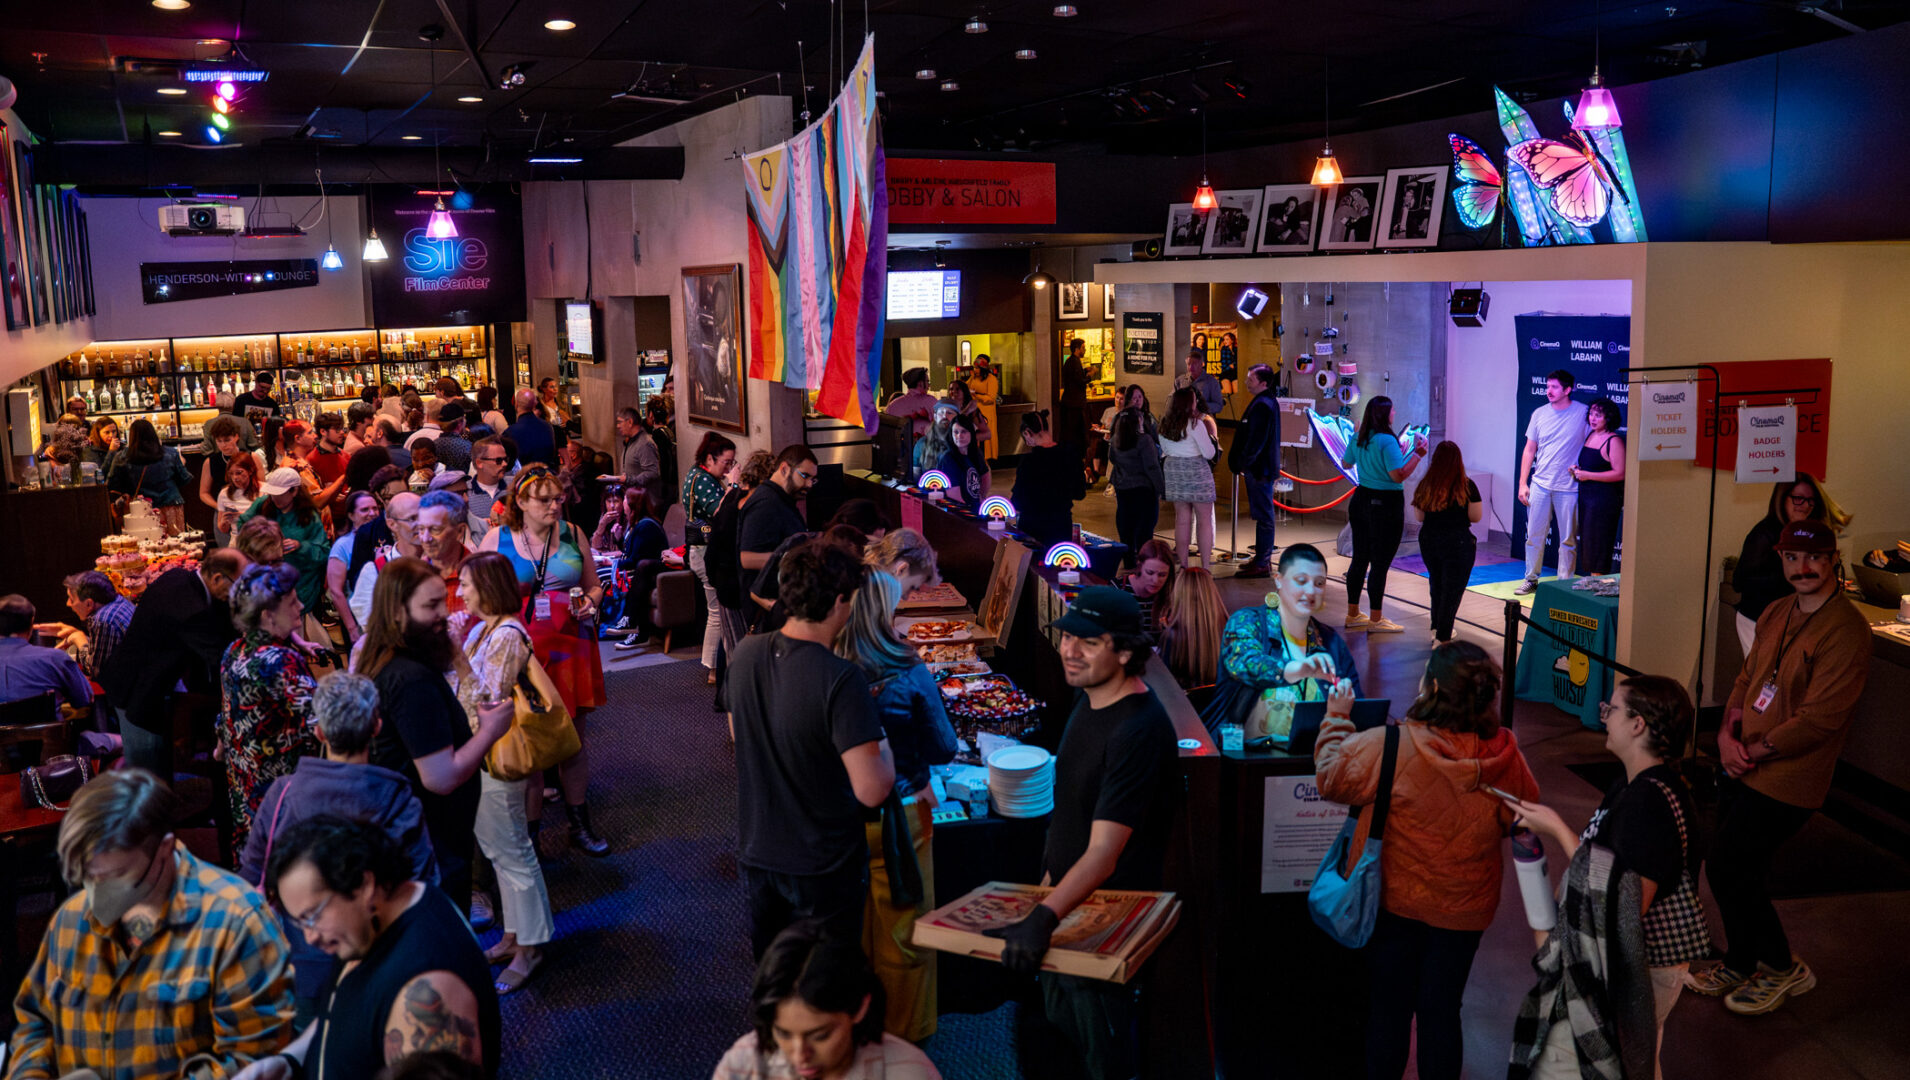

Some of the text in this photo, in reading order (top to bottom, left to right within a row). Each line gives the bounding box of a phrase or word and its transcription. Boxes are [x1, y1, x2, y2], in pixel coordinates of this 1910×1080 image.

[887, 187, 1021, 207] OBBY & SALON
[403, 226, 488, 273] Sie
[267, 270, 311, 282] OUNGE
[404, 276, 491, 292] FilmCenter
[1207, 337, 1221, 350] MY
[1571, 340, 1602, 350] WILLIAM
[1207, 350, 1221, 362] OLD
[1570, 352, 1602, 362] LABAHN
[1206, 362, 1223, 375] ASS
[1532, 376, 1547, 385] WILL
[1531, 387, 1547, 396] LABA
[1576, 383, 1597, 391] CinemaQ
[1606, 382, 1629, 393] WILLIA
[1656, 413, 1682, 421] TICKET
[1750, 415, 1784, 427] CinemaQ
[1651, 426, 1687, 435] HOLDERS
[1753, 437, 1781, 445] BADGE
[1749, 450, 1785, 459] HOLDERS
